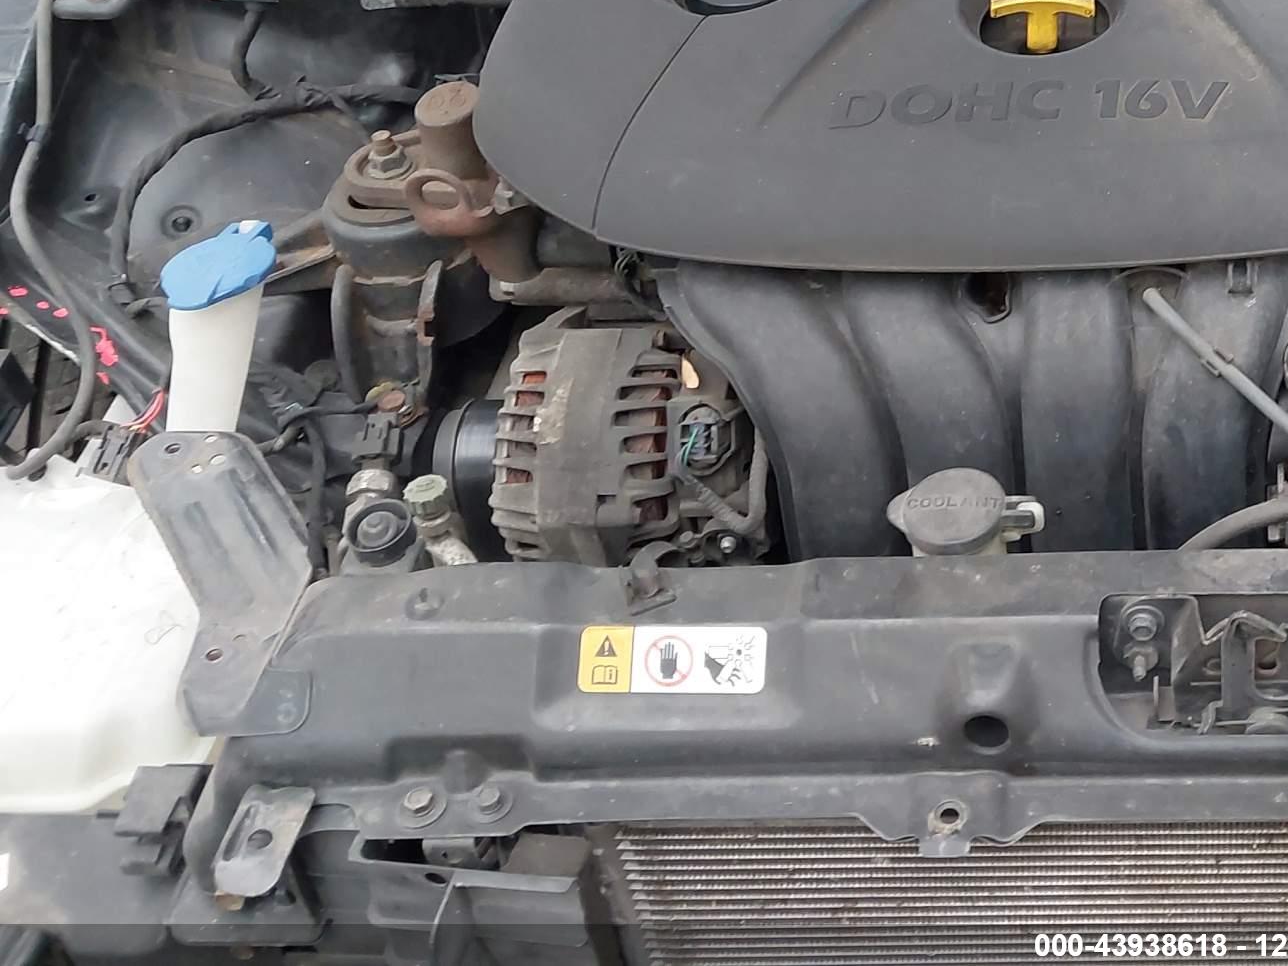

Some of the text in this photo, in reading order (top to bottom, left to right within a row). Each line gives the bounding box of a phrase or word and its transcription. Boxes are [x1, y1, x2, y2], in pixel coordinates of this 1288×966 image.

[828, 79, 1230, 131] DOHC 16V
[907, 496, 1003, 510] COOLANT
